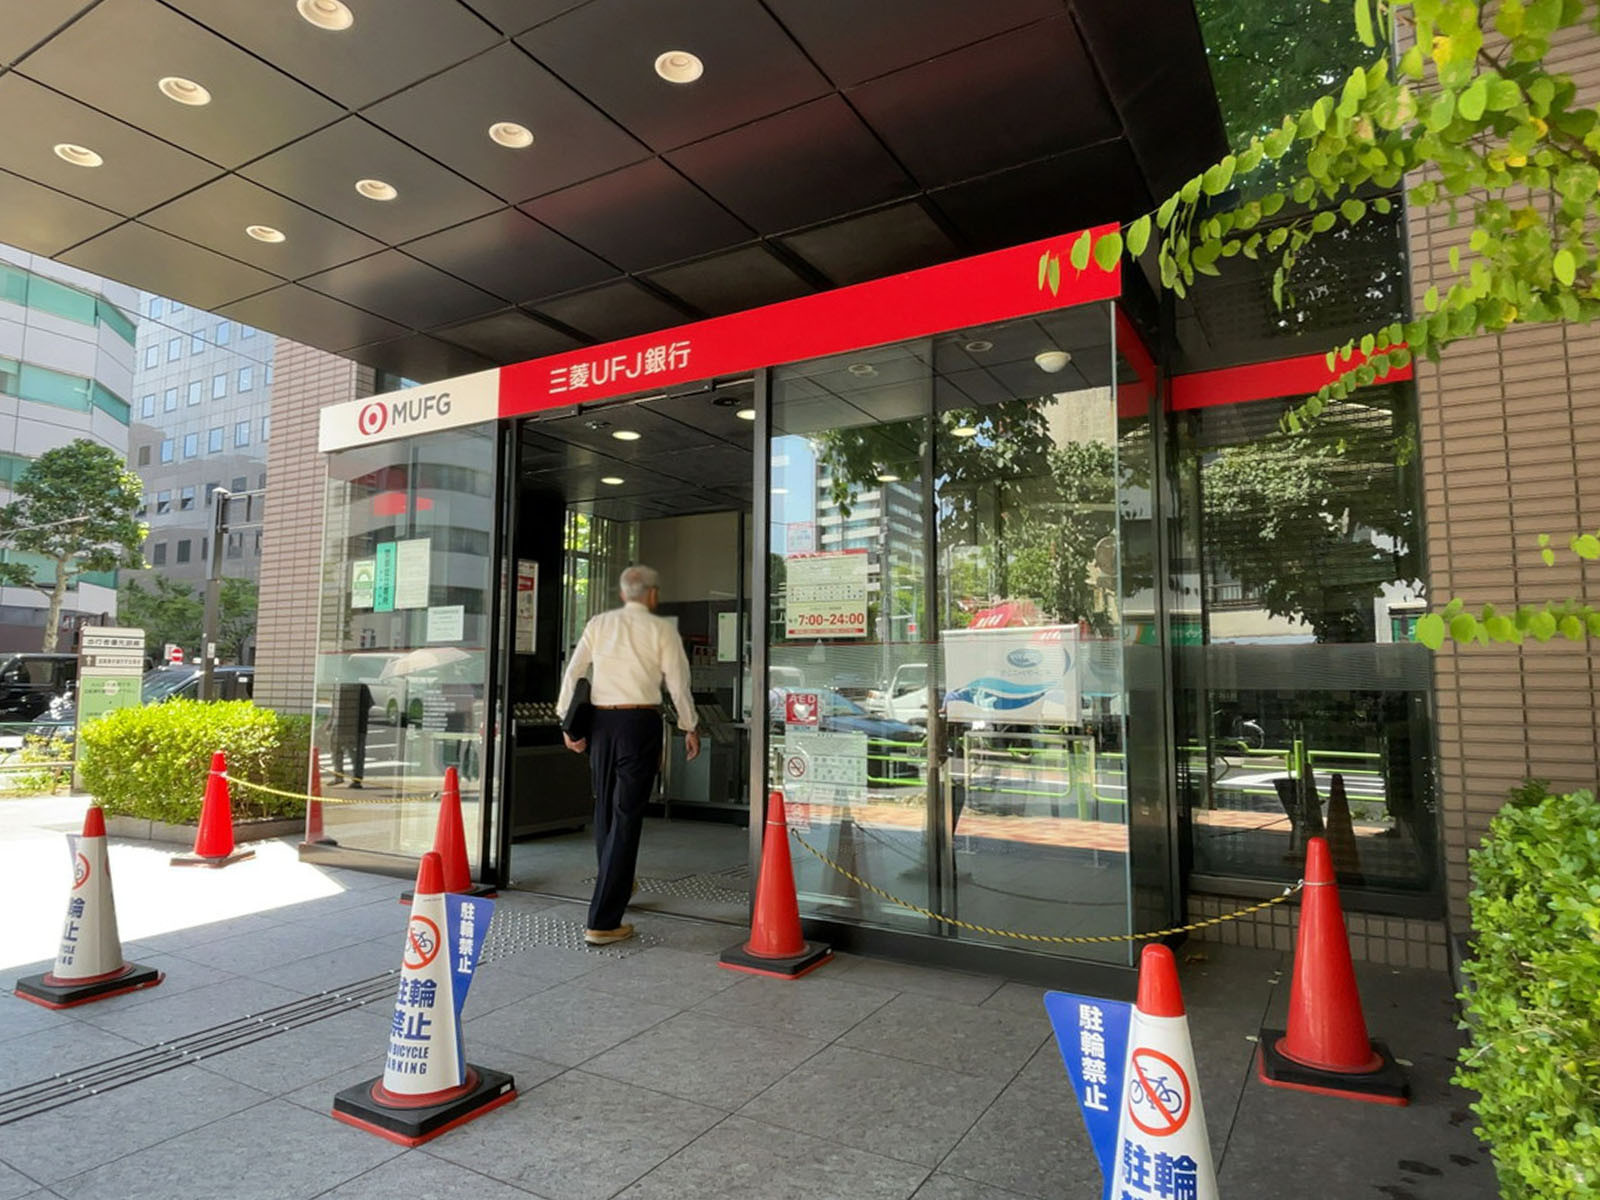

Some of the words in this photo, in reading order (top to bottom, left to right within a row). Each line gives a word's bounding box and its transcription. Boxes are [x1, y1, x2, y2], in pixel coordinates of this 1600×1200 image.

[548, 340, 692, 394] 三菱UFJ銀行
[391, 393, 451, 425] MUFG
[789, 694, 816, 704] AED
[457, 901, 476, 974] 駐輪禁止
[1078, 1003, 1109, 1112] 駐輪禁止
[1121, 1138, 1198, 1200] 駐輪
